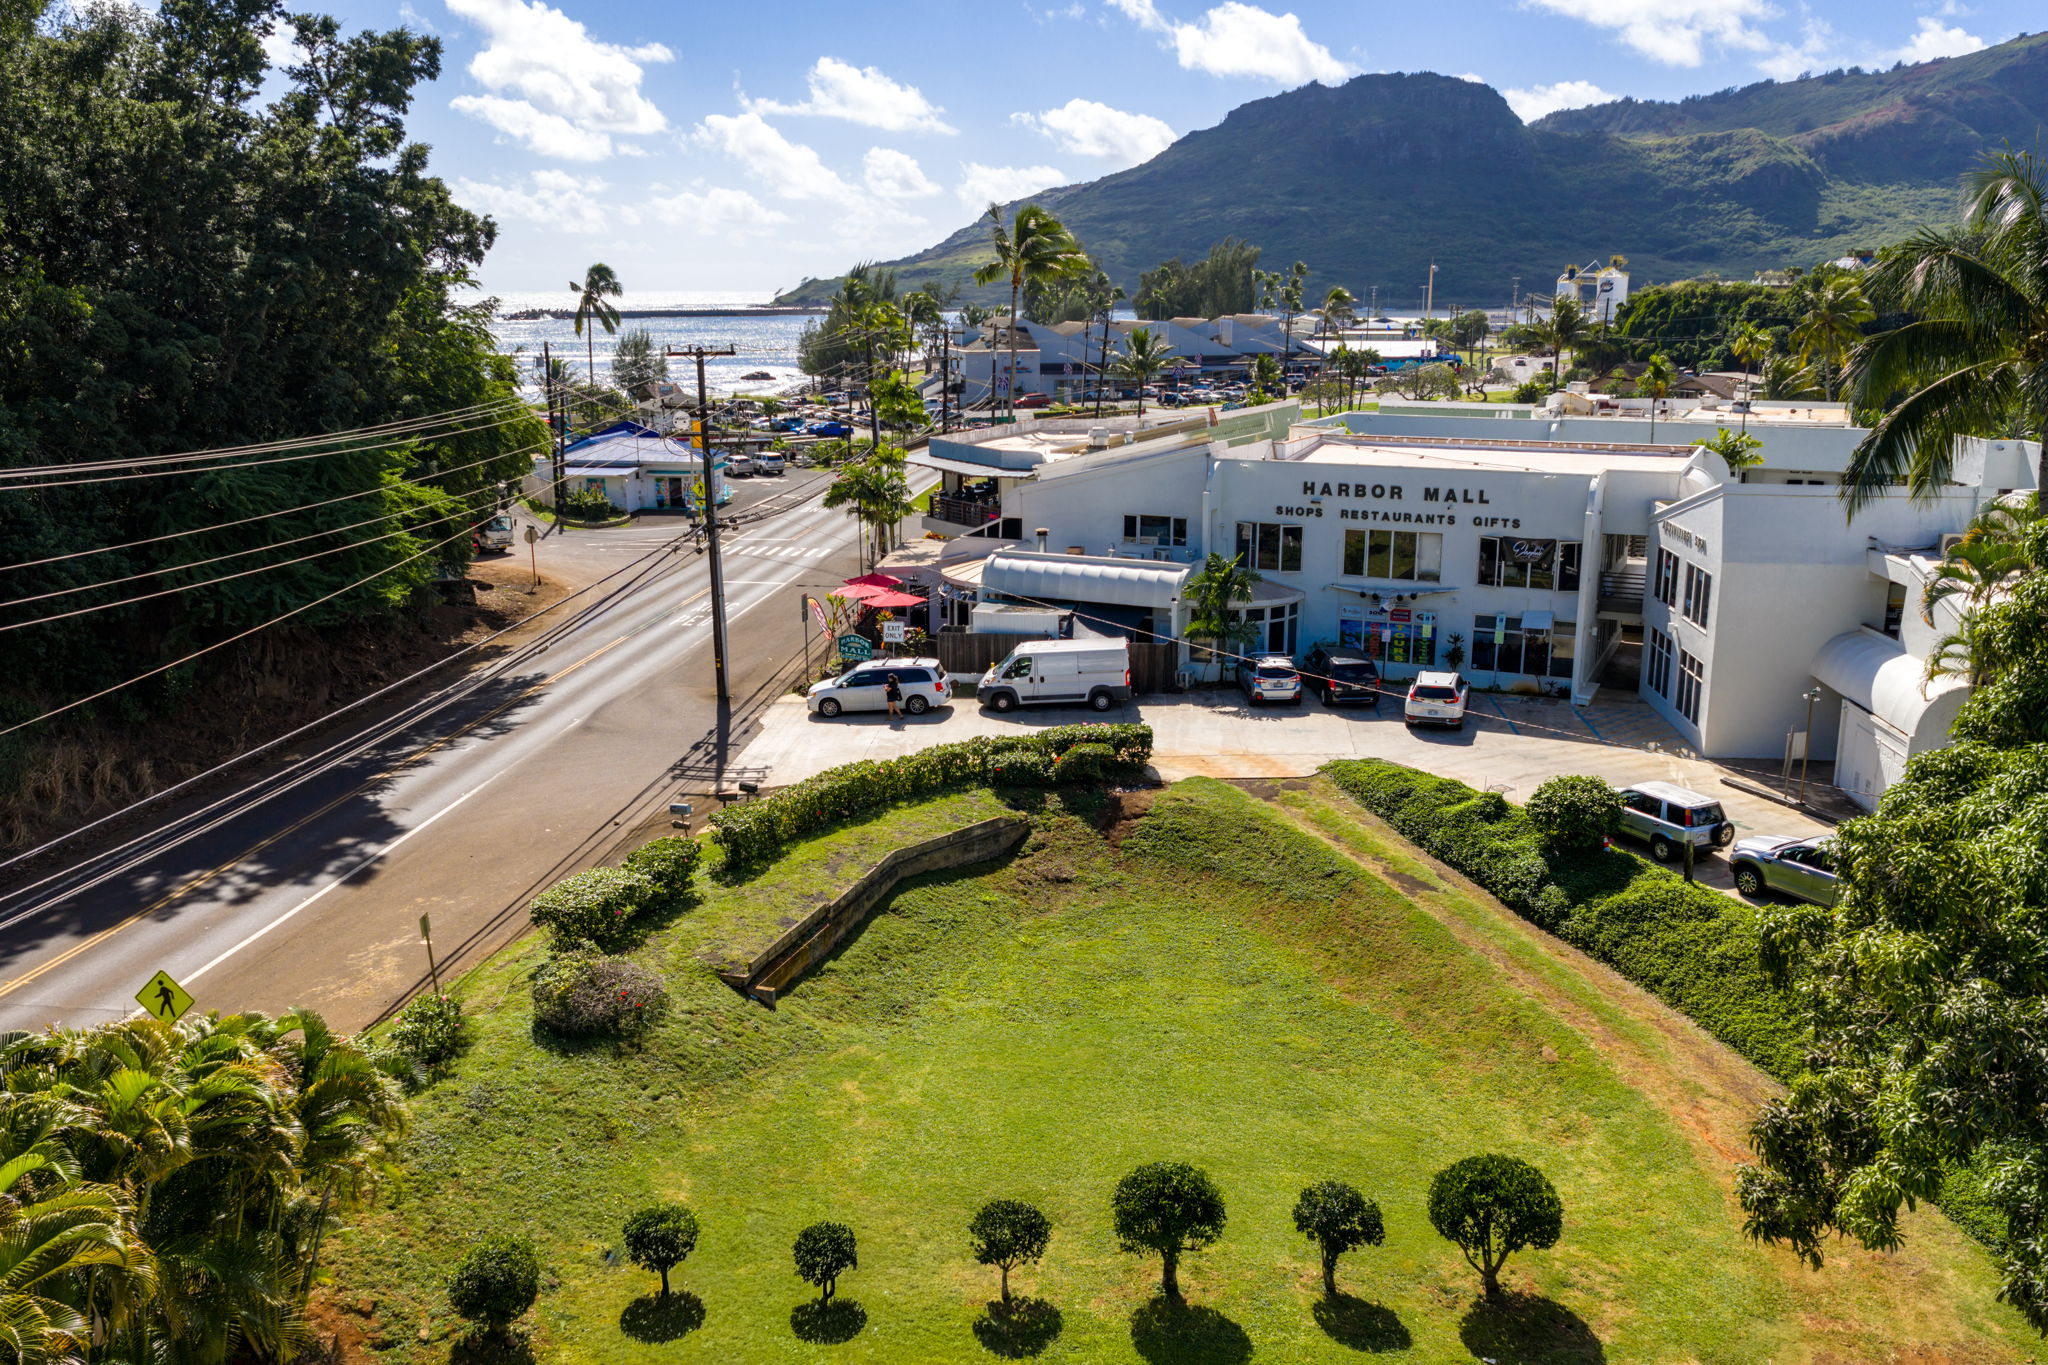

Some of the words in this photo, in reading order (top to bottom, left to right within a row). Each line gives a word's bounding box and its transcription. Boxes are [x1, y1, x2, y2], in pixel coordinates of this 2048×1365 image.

[1303, 481, 1403, 500] HARBOR
[1424, 487, 1490, 504] MALL
[1276, 506, 1323, 517] SHOPS
[1340, 509, 1456, 525] RESTAURANTS
[1473, 516, 1521, 529] GIFTS
[840, 646, 870, 655] MALL
[841, 637, 870, 648] HARBOR
[1393, 624, 1405, 662] TOURS
